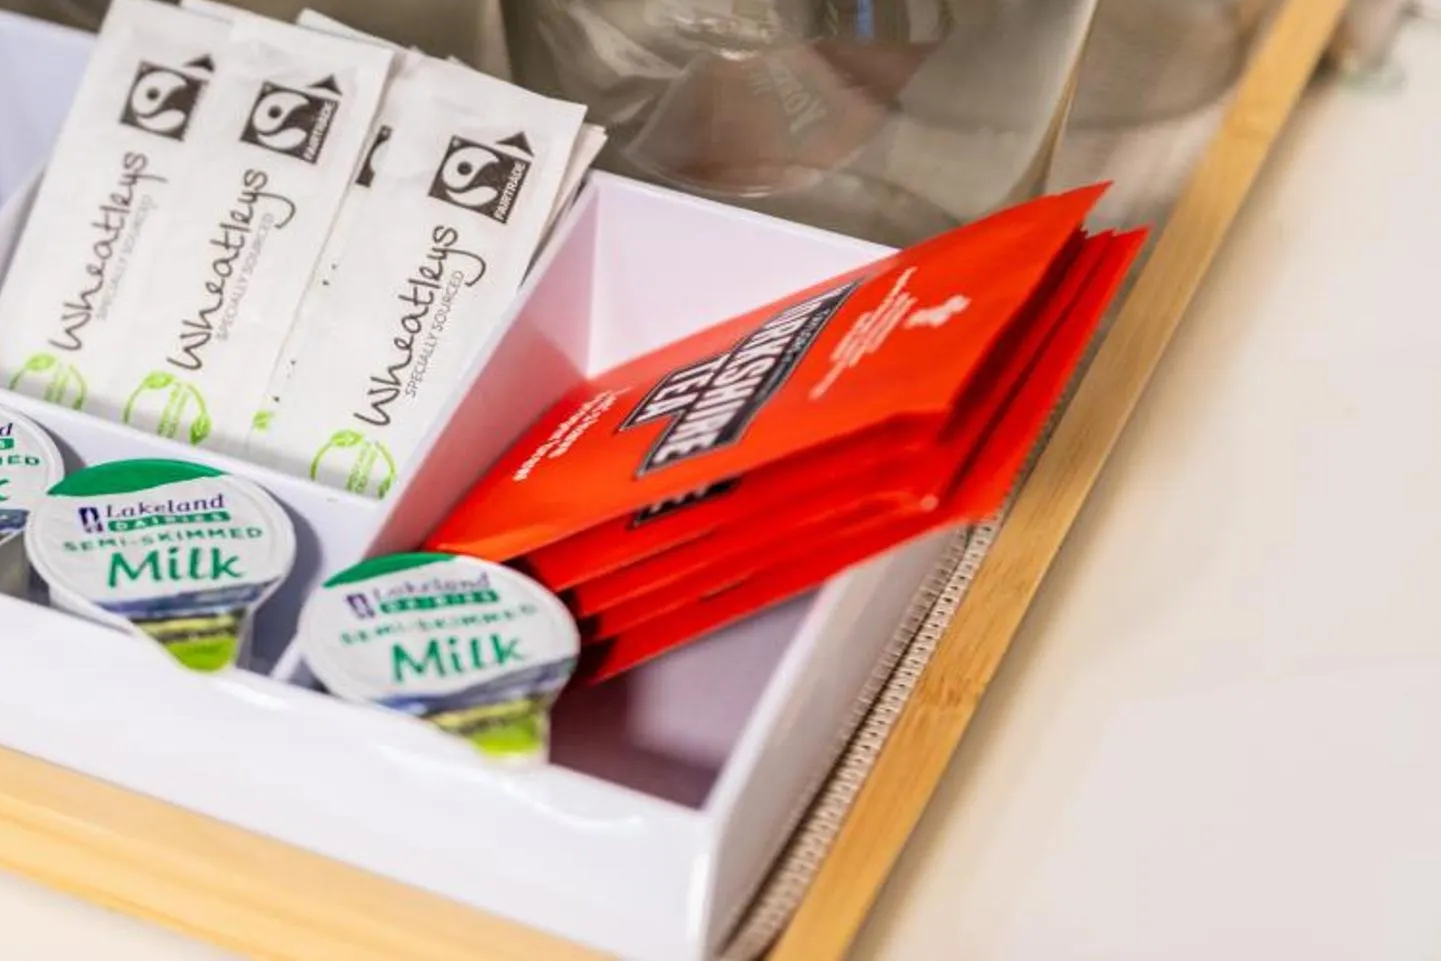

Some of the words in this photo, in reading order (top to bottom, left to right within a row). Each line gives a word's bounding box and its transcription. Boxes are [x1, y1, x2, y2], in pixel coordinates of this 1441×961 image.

[50, 151, 168, 351] Wheatleys
[166, 168, 296, 371] Wheatleys
[353, 225, 487, 426] Wheatleys
[405, 332, 439, 397] SPECIALLY
[431, 270, 465, 333] SOURCED
[633, 353, 731, 424] TEA
[63, 527, 264, 552] SEMI-SKIMMED
[106, 493, 226, 518] Lakeland
[108, 546, 245, 588] Milk
[391, 633, 527, 683] Milk
